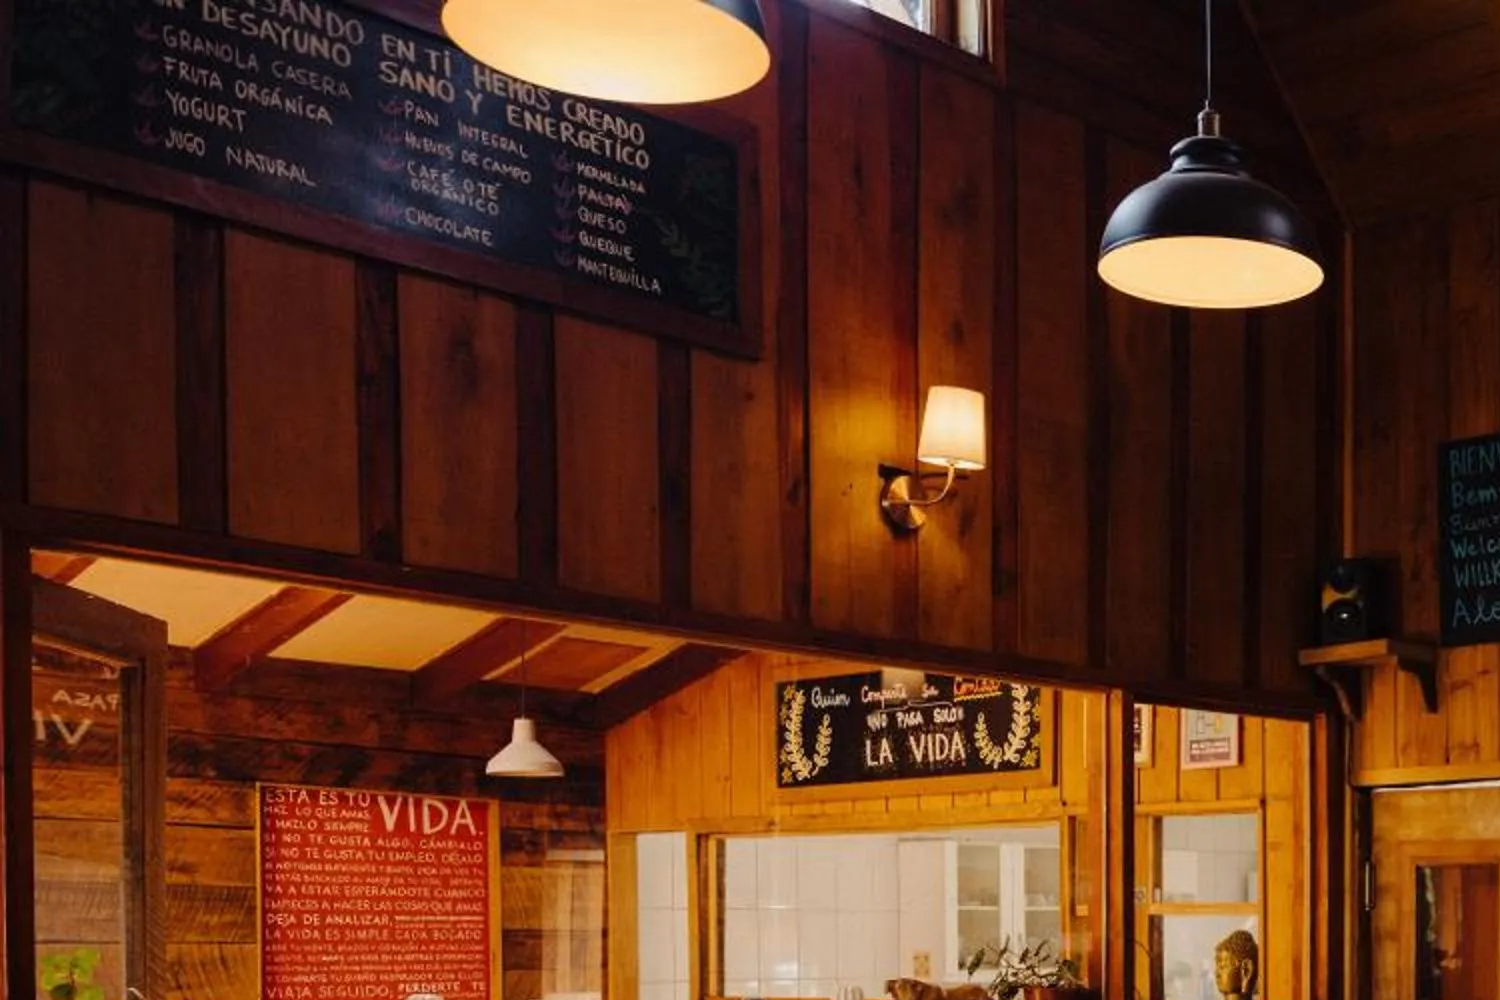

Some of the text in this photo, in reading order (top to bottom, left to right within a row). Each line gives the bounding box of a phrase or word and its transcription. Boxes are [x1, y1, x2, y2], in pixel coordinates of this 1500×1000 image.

[162, 24, 352, 98] GRANOLA CASERA
[163, 56, 223, 91] FRUTA
[202, 0, 351, 66] DESAYUNO
[379, 61, 455, 103] SANO
[465, 89, 484, 115] Y
[245, 0, 365, 45] SANDO
[381, 33, 416, 62] EN
[473, 64, 550, 111] HEMOS
[562, 99, 645, 145] CREADO
[165, 89, 247, 133] YOGURT
[404, 100, 529, 159] PAN INTEGRAL
[165, 128, 317, 187] JUGO NATURAL
[461, 149, 478, 167] DE
[482, 157, 532, 184] CAMPO
[463, 178, 475, 194] O
[577, 161, 646, 194] MERMELADA
[405, 206, 493, 246] CHOCOLATE
[578, 207, 627, 235] QUESO
[578, 231, 635, 262] QUEQUE
[896, 711, 924, 729] PASA
[865, 730, 966, 767] LA VIDA
[265, 788, 310, 804] ESTA
[319, 790, 339, 806] ES
[281, 847, 300, 859] NO
[305, 847, 321, 859] TE
[323, 848, 365, 861] GUSTA
[282, 834, 301, 843] NO
[309, 833, 325, 845] TE
[329, 835, 371, 848] GUSTA
[266, 913, 297, 927] DEJA
[304, 913, 320, 926] DE
[287, 929, 320, 940] VIDA
